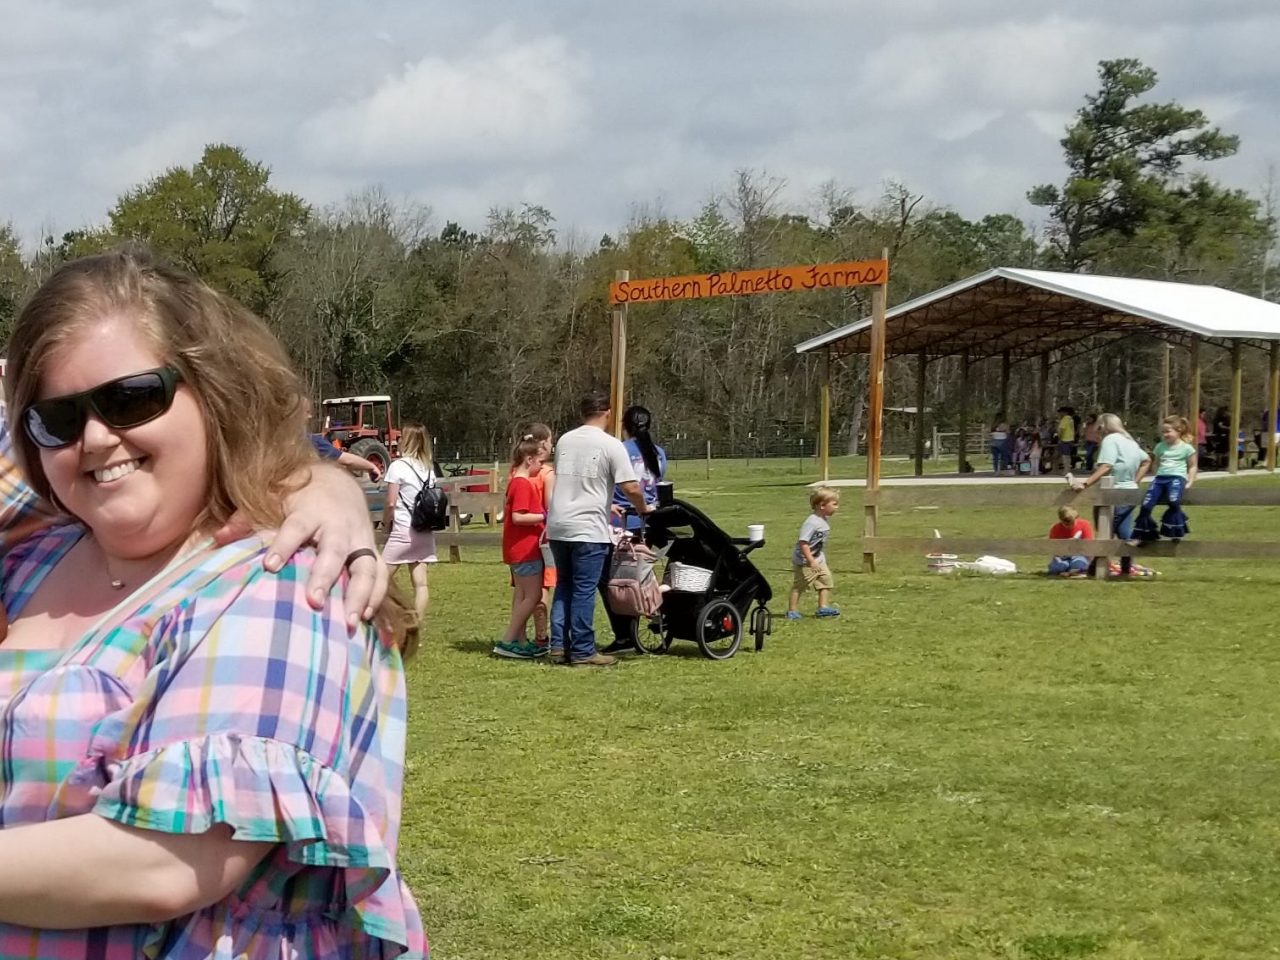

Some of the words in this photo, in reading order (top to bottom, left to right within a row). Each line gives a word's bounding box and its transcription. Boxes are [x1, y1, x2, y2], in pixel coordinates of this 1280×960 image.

[614, 281, 703, 303] Southern
[706, 270, 793, 297] Palmetto
[800, 266, 883, 290] Farms
